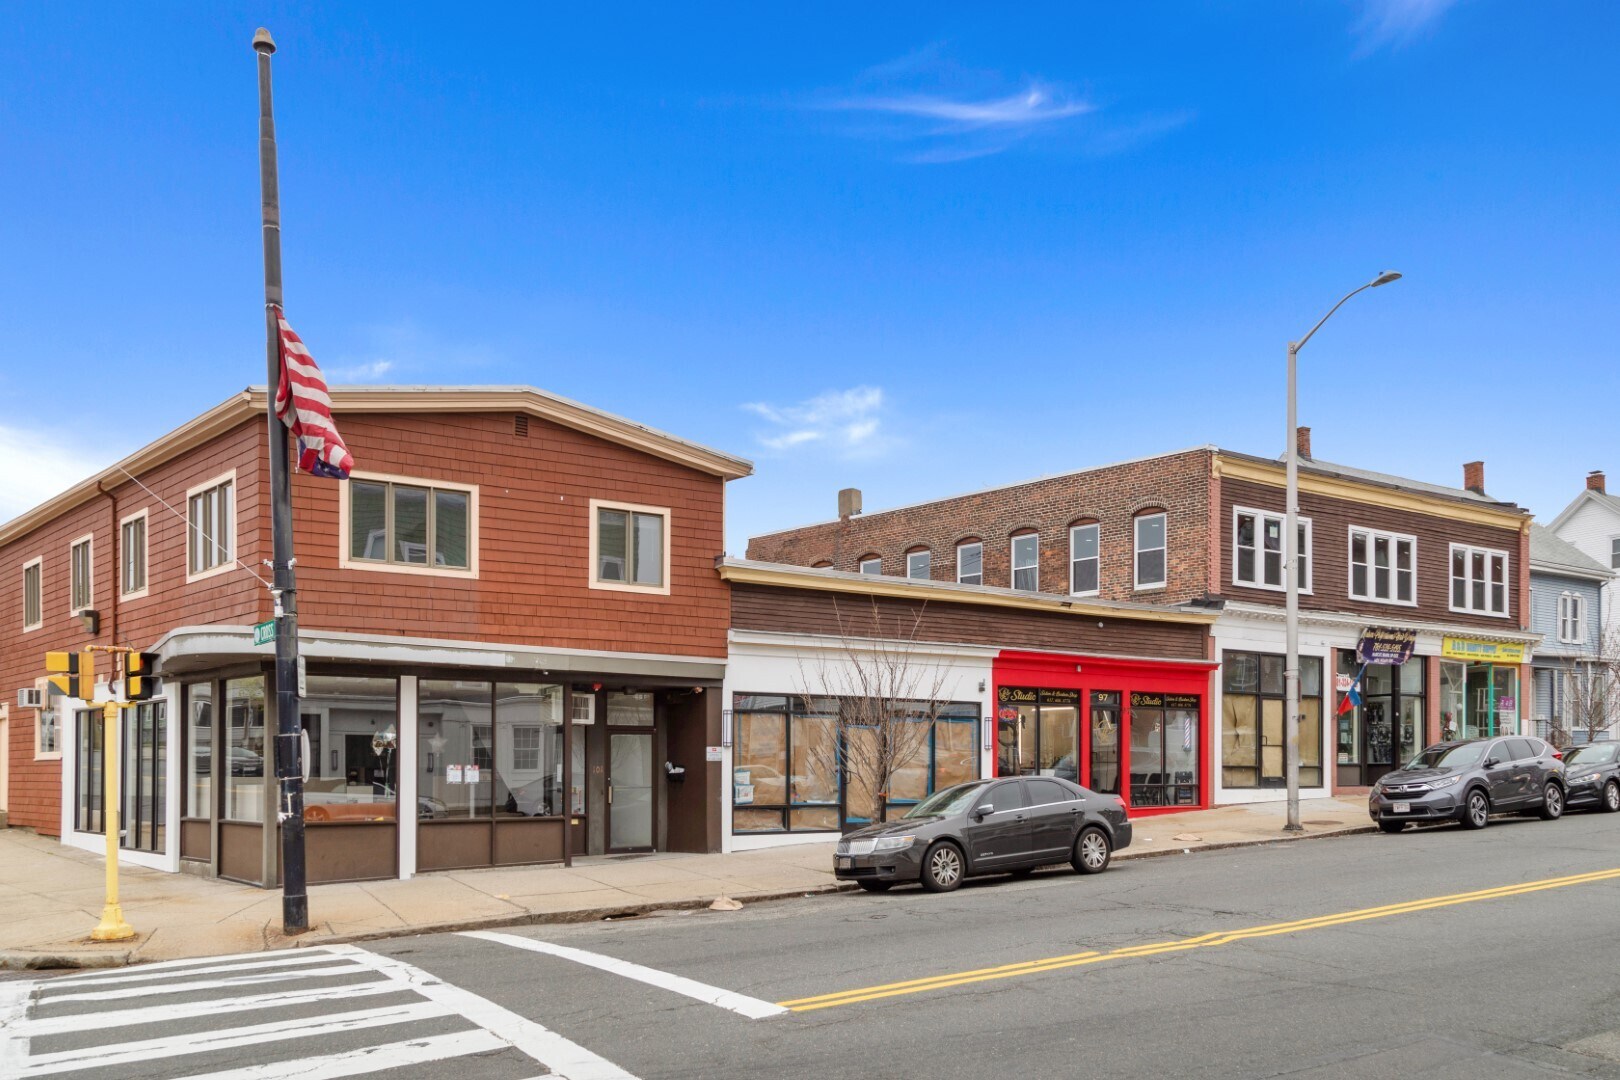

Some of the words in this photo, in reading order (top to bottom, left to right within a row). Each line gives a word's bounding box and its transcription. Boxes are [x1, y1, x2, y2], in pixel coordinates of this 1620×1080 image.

[260, 623, 274, 640] CROSS
[1010, 690, 1036, 700] Studio
[1140, 696, 1162, 706] Studio
